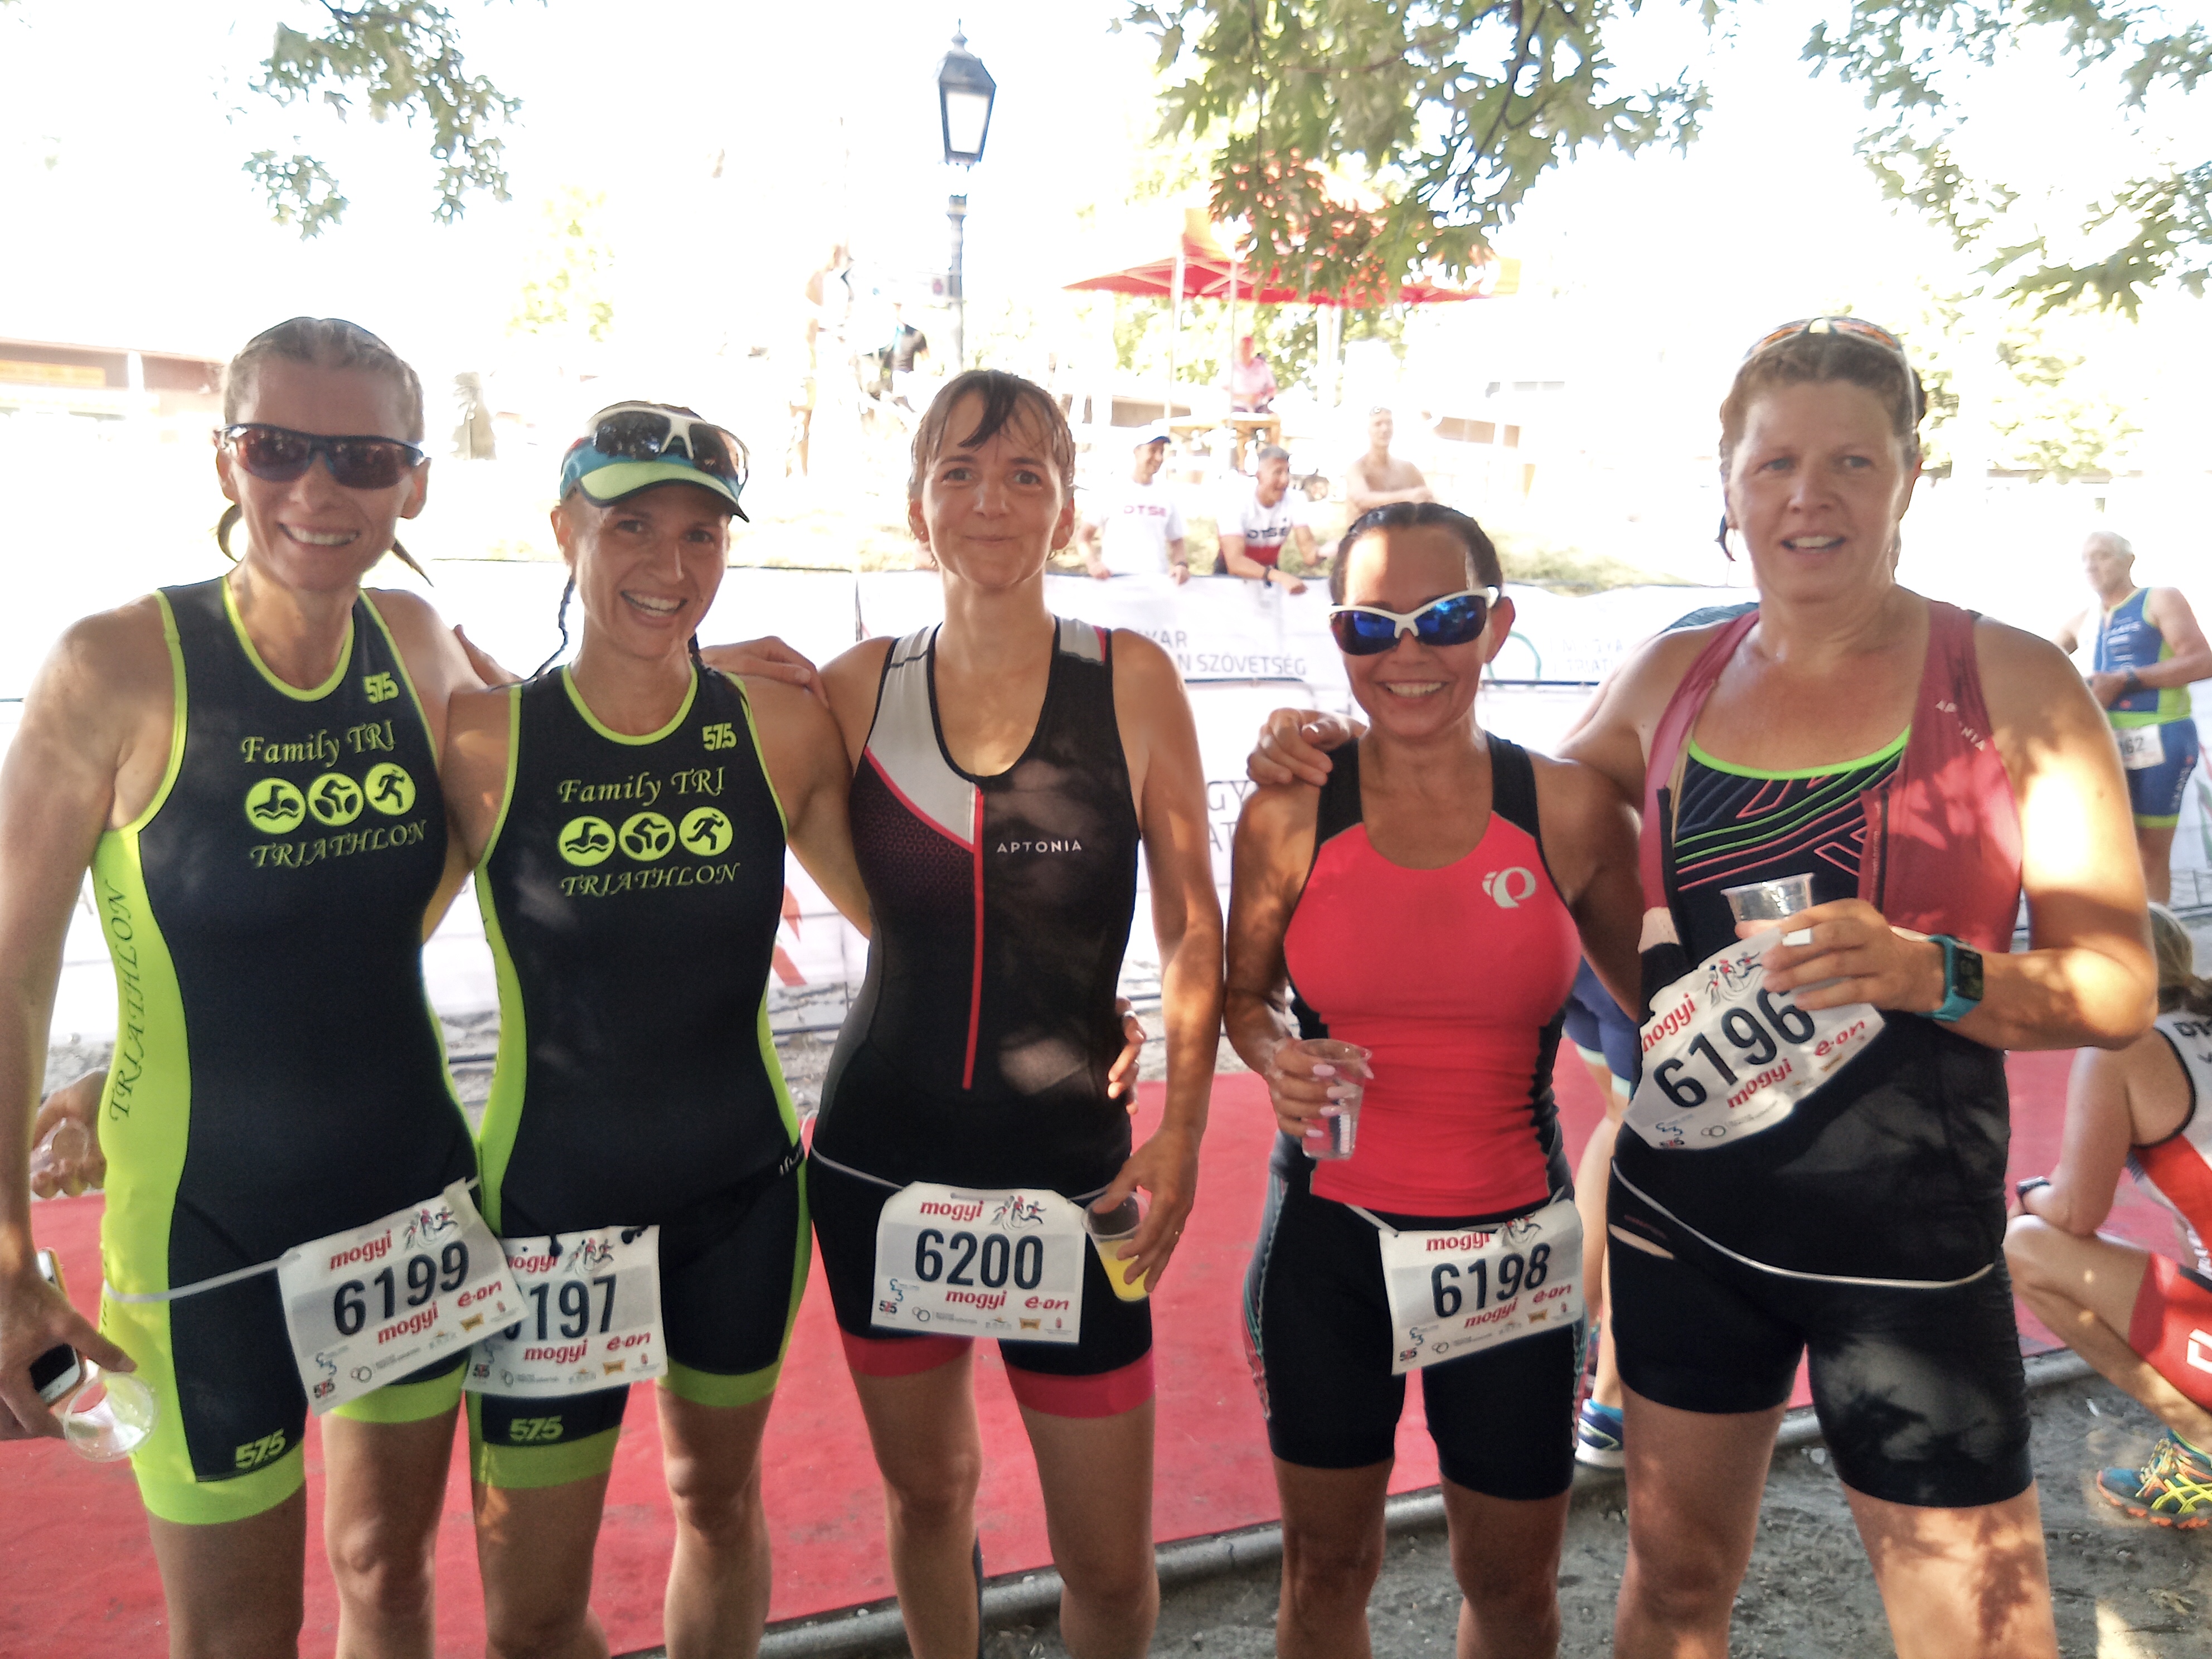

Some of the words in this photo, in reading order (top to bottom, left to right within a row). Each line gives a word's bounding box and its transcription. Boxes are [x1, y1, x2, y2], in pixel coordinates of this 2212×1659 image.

[1196, 652, 1307, 676] SZÖVETSÉG
[364, 671, 399, 704] 575
[240, 728, 340, 768] Family
[346, 719, 396, 753] TRI
[702, 722, 738, 751] 575
[558, 772, 662, 807] Family
[671, 766, 725, 797] TRI
[250, 819, 427, 869] TRIATHLON
[996, 839, 1082, 853] APTONIA
[560, 862, 741, 898] TRIATHLON
[105, 879, 145, 1122] TRIATHLON
[1653, 987, 1816, 1108] 6196
[1726, 1057, 1794, 1109] mogyi
[920, 1200, 984, 1222] mogyi
[330, 1229, 393, 1272] mogyi
[915, 1228, 1044, 1290] 6200
[334, 1240, 469, 1336] 6199
[945, 1289, 1008, 1311] mogyi
[1431, 1242, 1551, 1319] 6198
[377, 1301, 439, 1345] mogyi
[504, 1273, 617, 1341] 197
[1464, 1297, 1519, 1330] mogyi
[524, 1338, 589, 1364] mogyi
[236, 1428, 286, 1469] 575
[509, 1415, 564, 1441] 575
